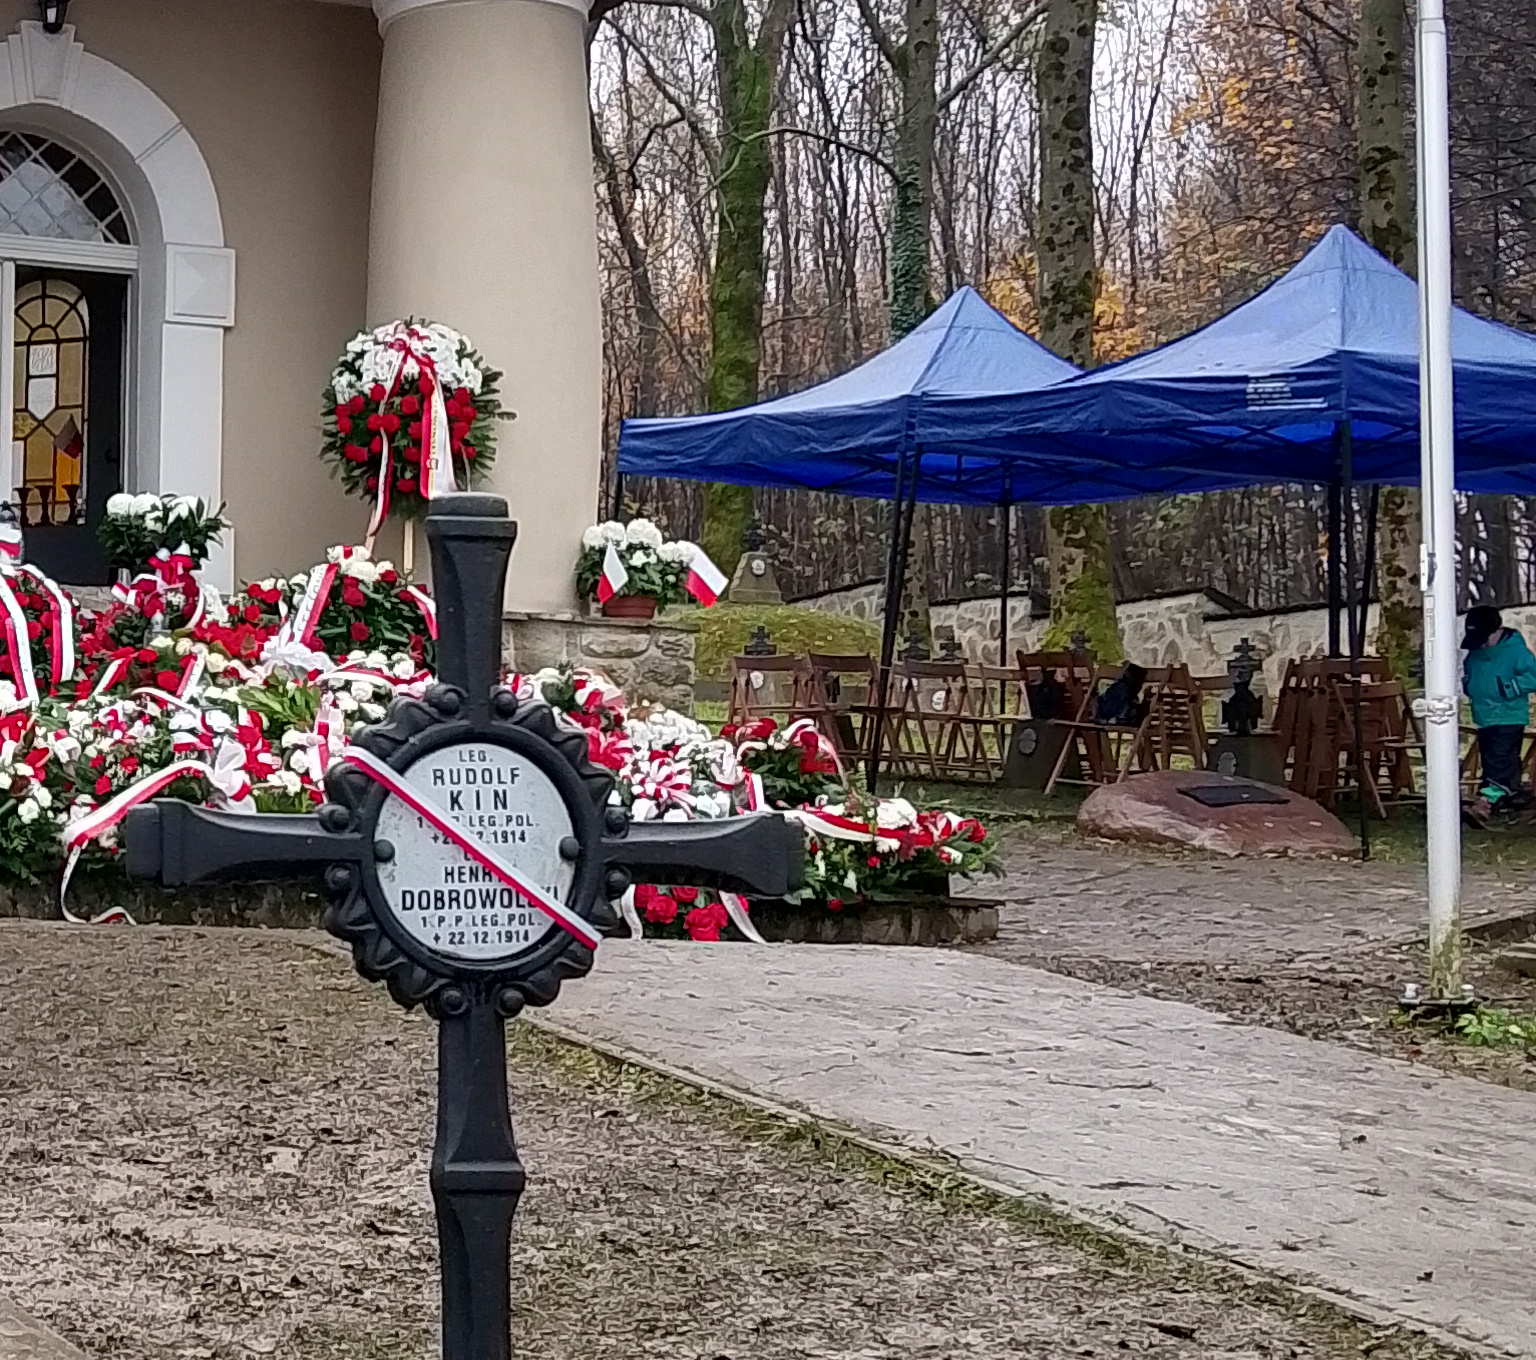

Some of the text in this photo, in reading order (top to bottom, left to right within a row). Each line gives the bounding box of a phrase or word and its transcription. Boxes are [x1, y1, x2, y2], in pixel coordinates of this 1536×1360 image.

[458, 749, 494, 763] LEG.
[432, 767, 520, 787] RUDOLF
[450, 788, 508, 811] KIN
[444, 864, 516, 884] HENR
[401, 885, 559, 911] DOBROWOLI
